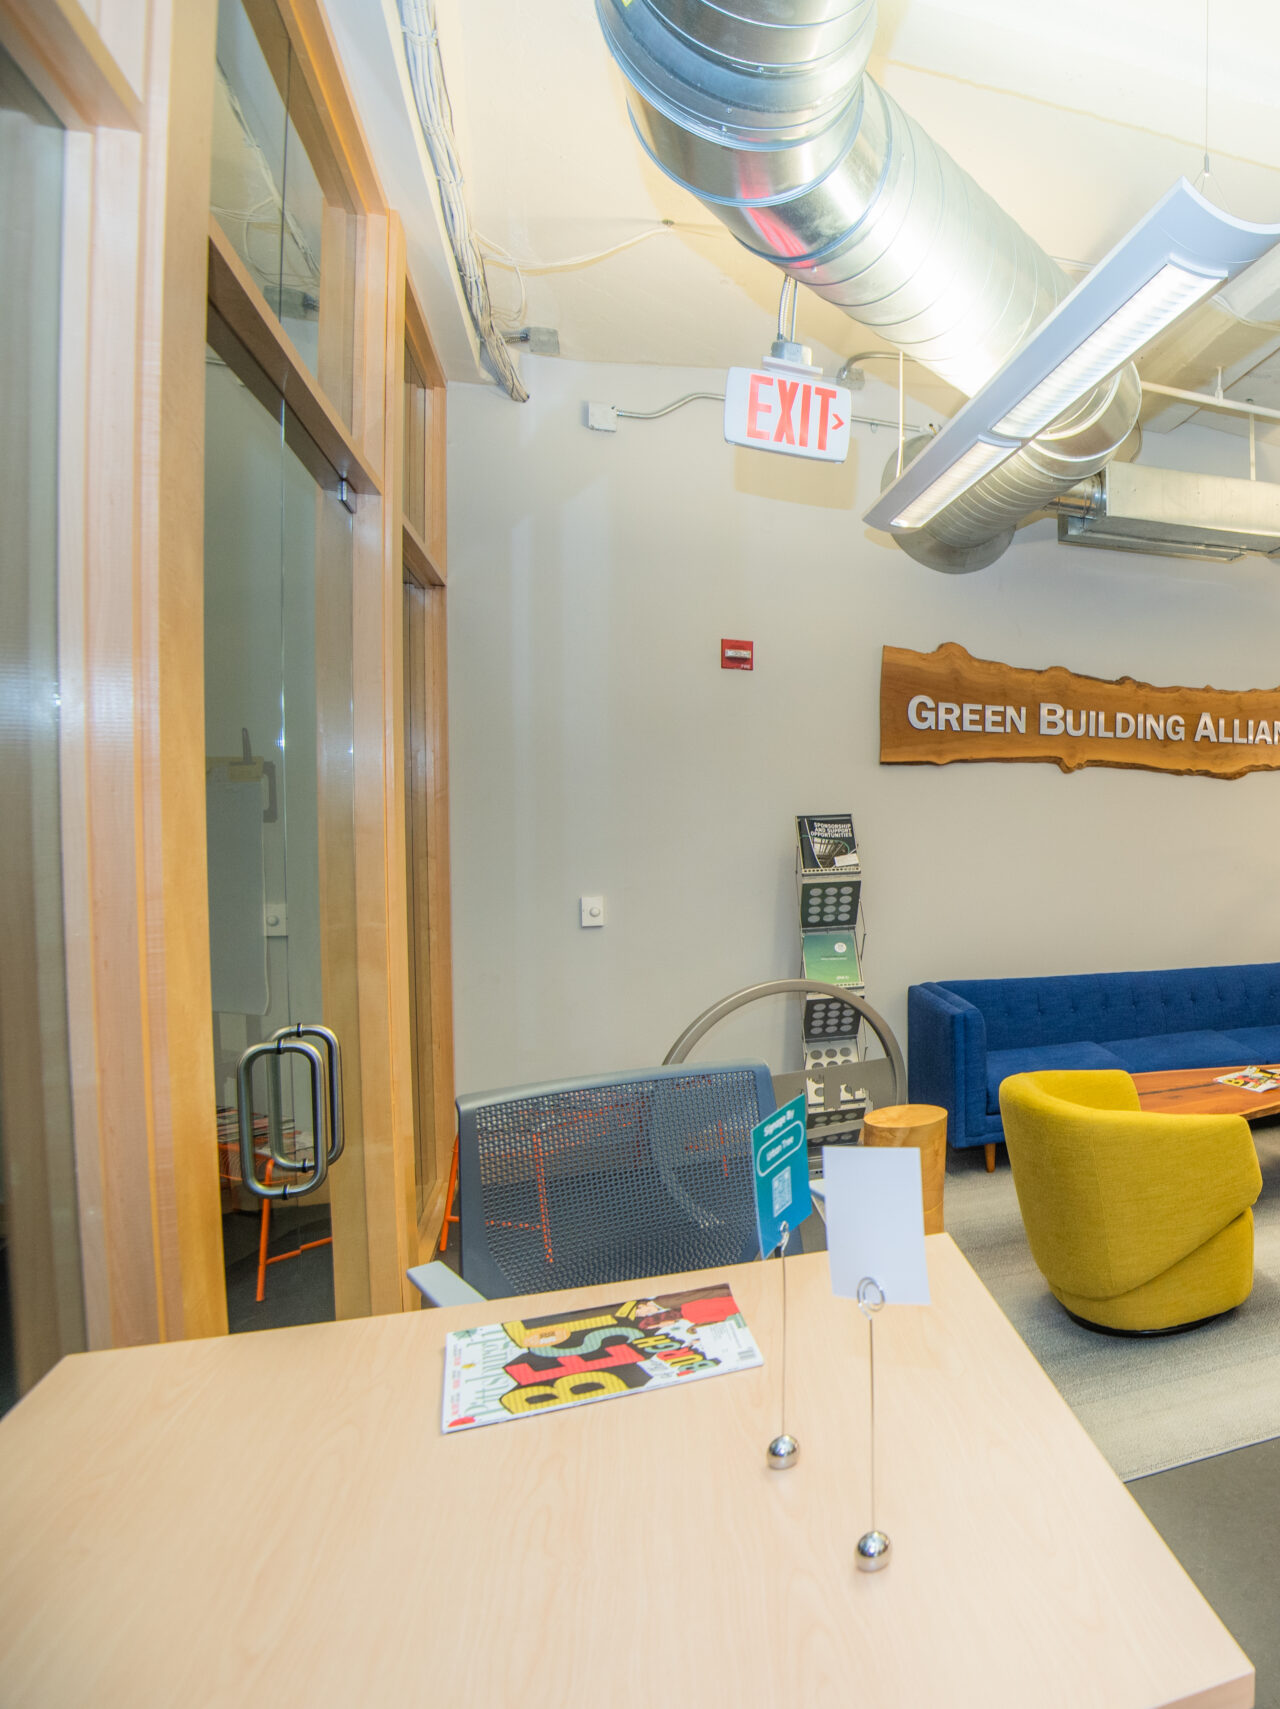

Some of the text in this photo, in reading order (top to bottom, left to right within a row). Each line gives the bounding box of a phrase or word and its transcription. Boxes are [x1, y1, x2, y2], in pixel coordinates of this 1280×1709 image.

[746, 373, 837, 451] EXIT
[907, 694, 1027, 735] GREEN
[1039, 702, 1186, 741] BUILDING
[810, 830, 853, 838] OPPORTUNITIES
[813, 821, 852, 830] SPONSORSHIP
[499, 1313, 646, 1415] BEST
